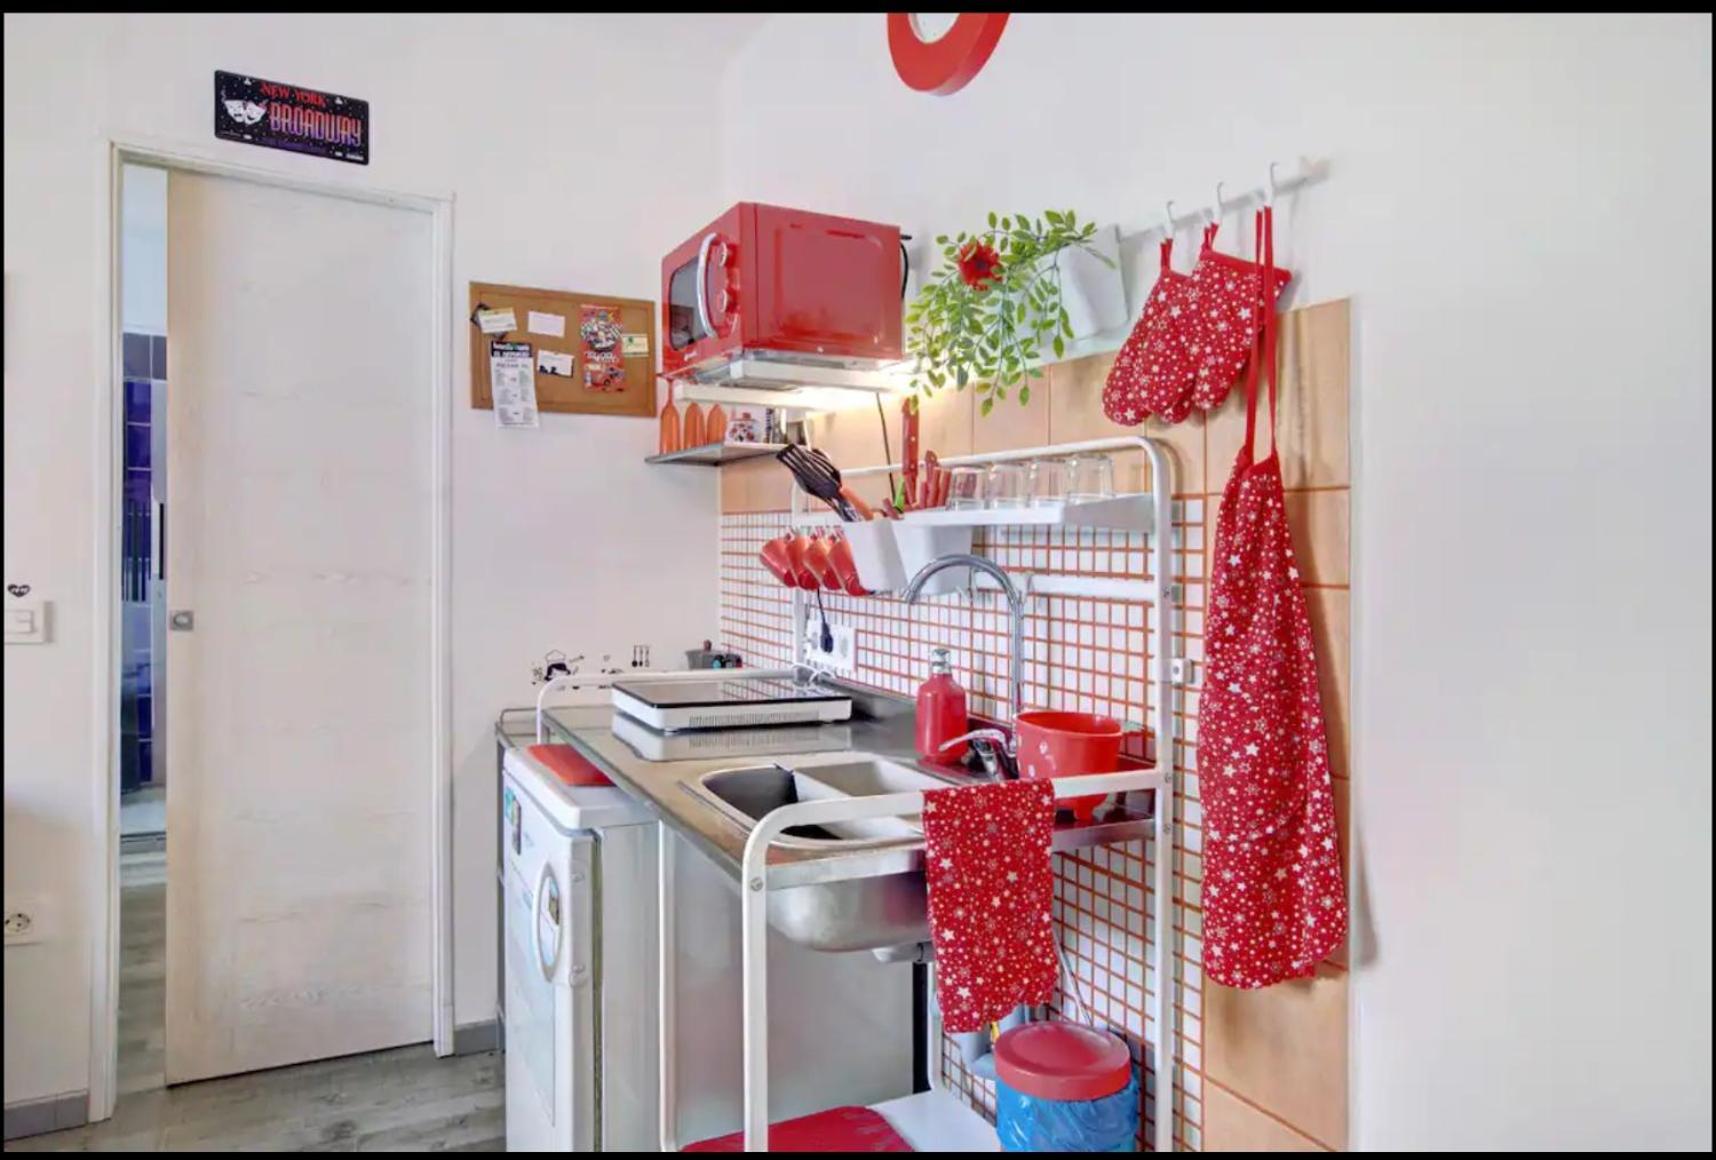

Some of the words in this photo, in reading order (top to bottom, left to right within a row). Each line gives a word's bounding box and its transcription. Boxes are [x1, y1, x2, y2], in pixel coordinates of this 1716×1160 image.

[259, 82, 289, 99] NEW
[295, 89, 327, 107] YORK
[269, 103, 362, 147] BROADWAY
